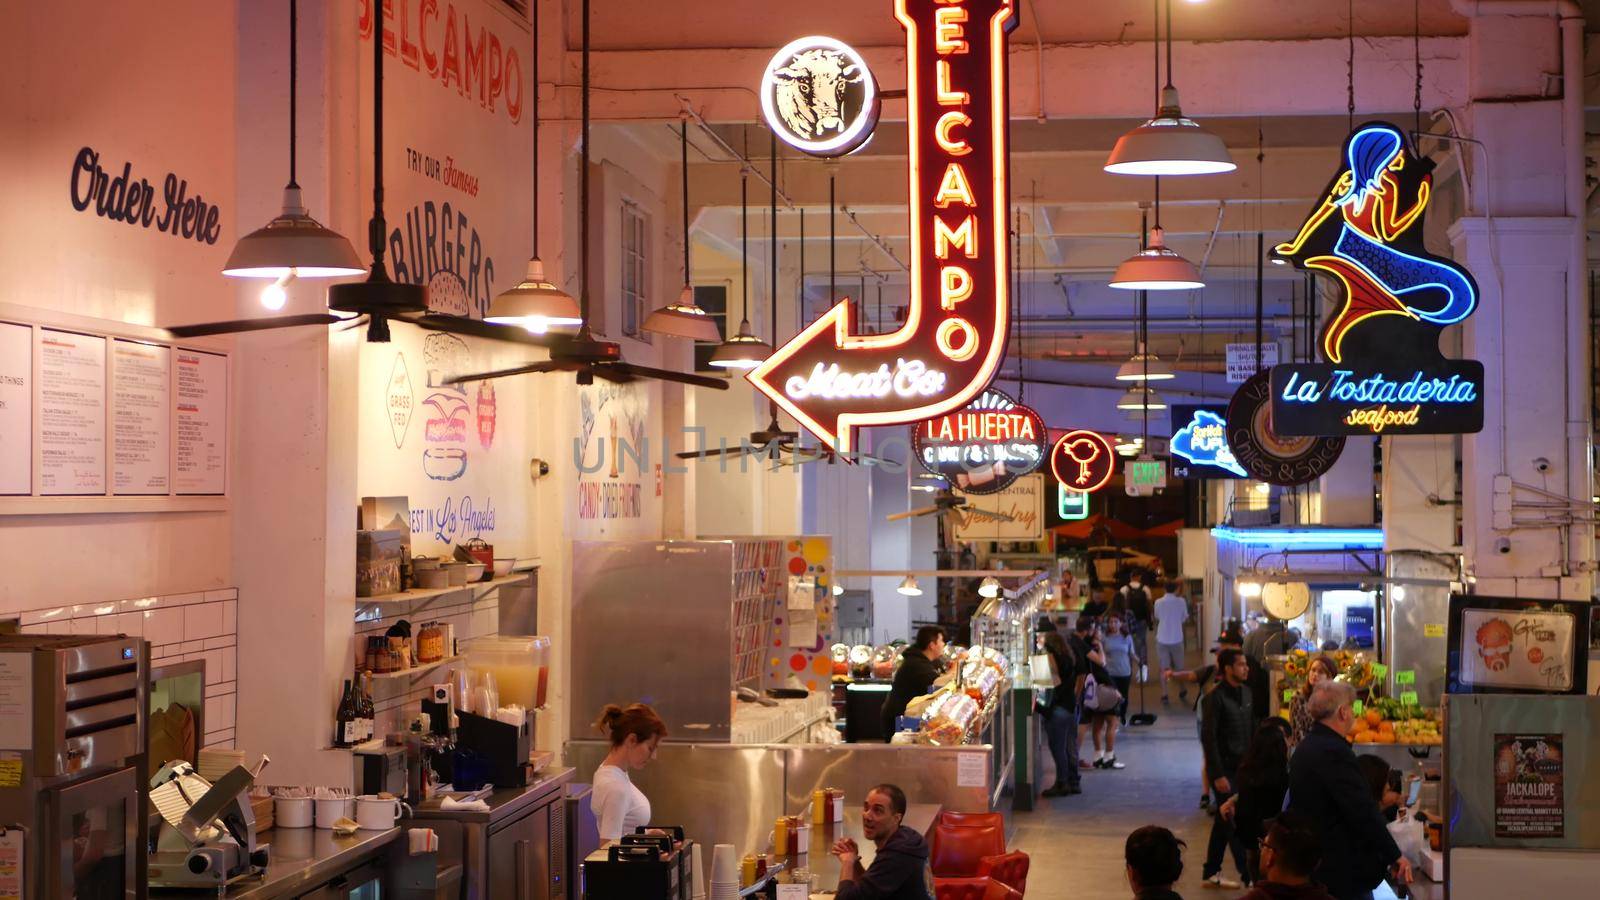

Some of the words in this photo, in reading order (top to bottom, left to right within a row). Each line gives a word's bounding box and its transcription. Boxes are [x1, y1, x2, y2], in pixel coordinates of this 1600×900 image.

[359, 0, 523, 125] ELCAMPO
[406, 148, 423, 174] TRY
[424, 155, 441, 181] OUR
[443, 156, 479, 198] Famous
[934, 0, 979, 361] ELCAMPO
[70, 147, 156, 229] Order
[156, 173, 221, 245] Here
[389, 200, 495, 312] BURGERS
[785, 361, 891, 398] Meat
[1281, 371, 1320, 402] La
[1328, 369, 1478, 402] Tostadería
[391, 395, 410, 409] GRASS
[394, 412, 406, 426] FED
[1344, 404, 1420, 433] seafood
[927, 417, 954, 442] LA
[957, 413, 1035, 442] HUERTA
[1133, 463, 1161, 480] EXIT
[1278, 463, 1295, 481] &
[579, 482, 600, 520] CANDY
[426, 509, 434, 533] IN
[435, 496, 457, 544] Los
[460, 495, 496, 538] Angeles
[1506, 782, 1555, 797] JACKALOPE
